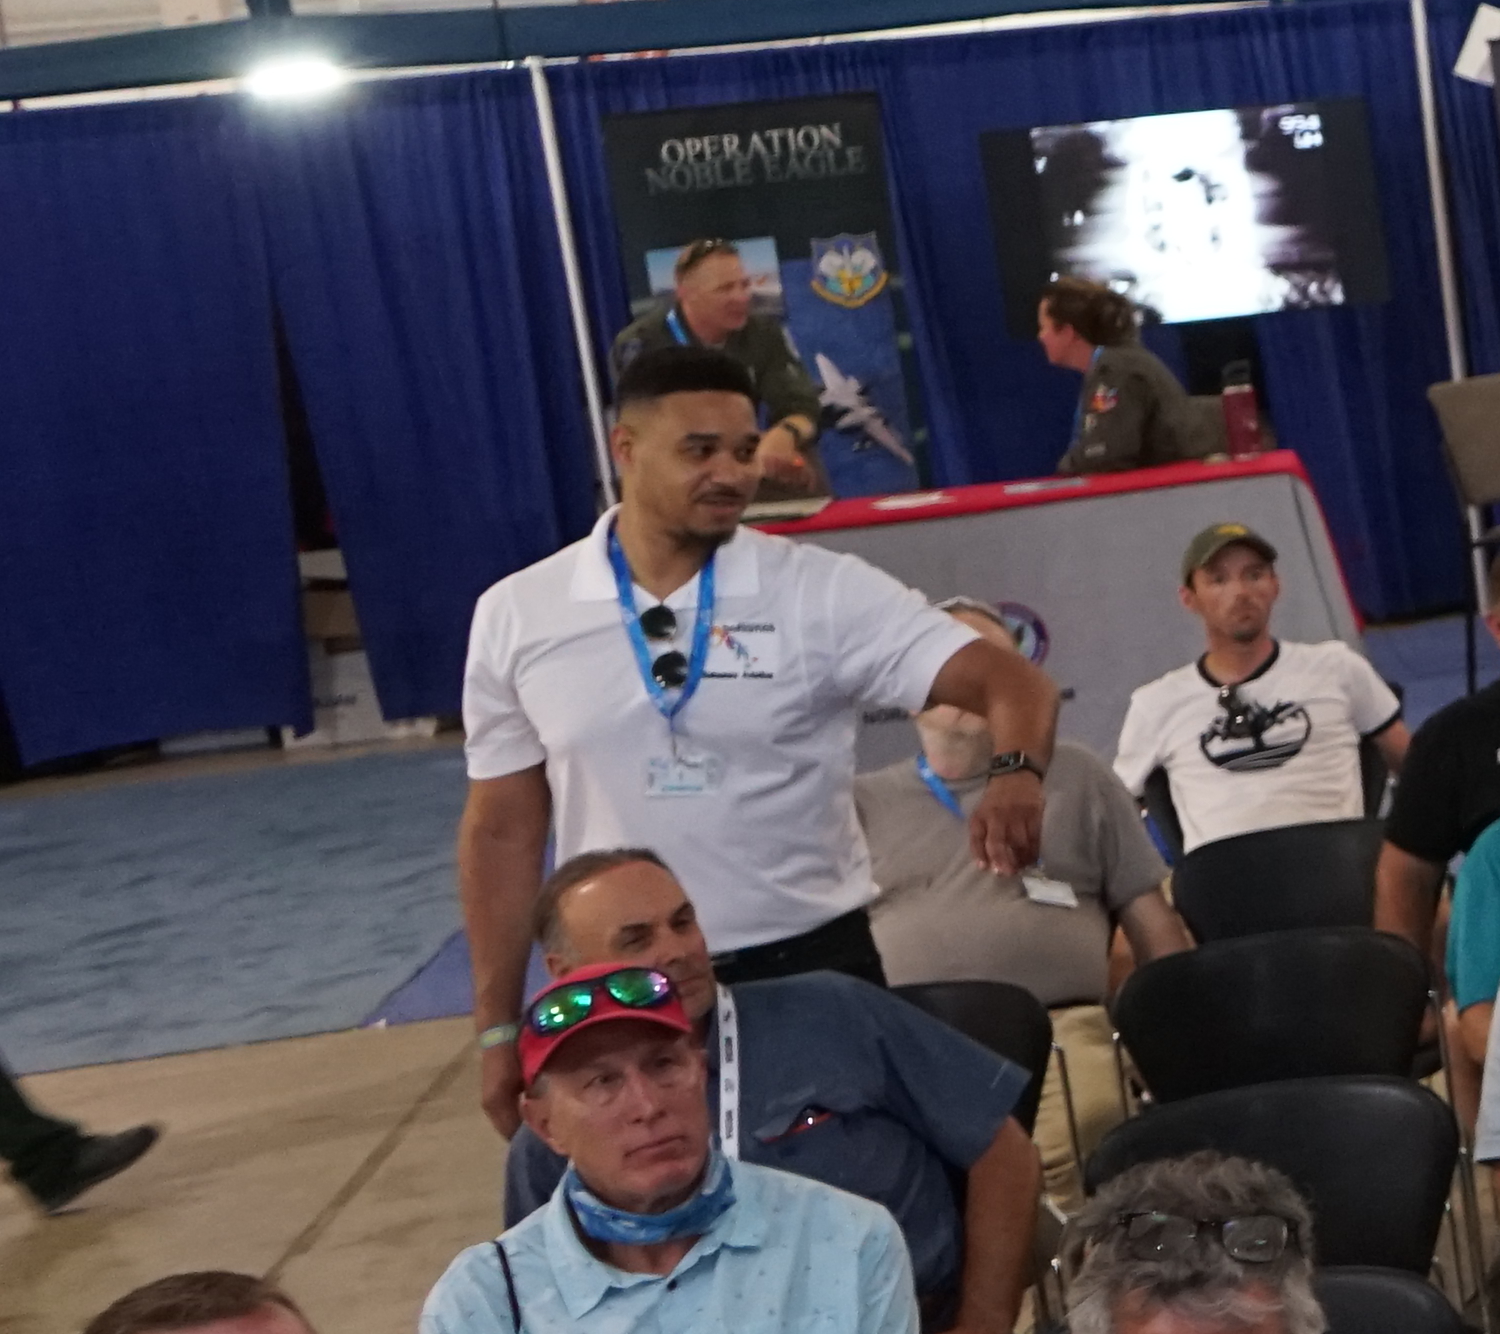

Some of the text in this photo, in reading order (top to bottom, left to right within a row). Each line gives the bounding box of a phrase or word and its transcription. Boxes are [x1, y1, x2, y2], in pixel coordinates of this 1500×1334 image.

[661, 123, 842, 164] OPERATION
[645, 146, 867, 194] NOBLE EAGLE
